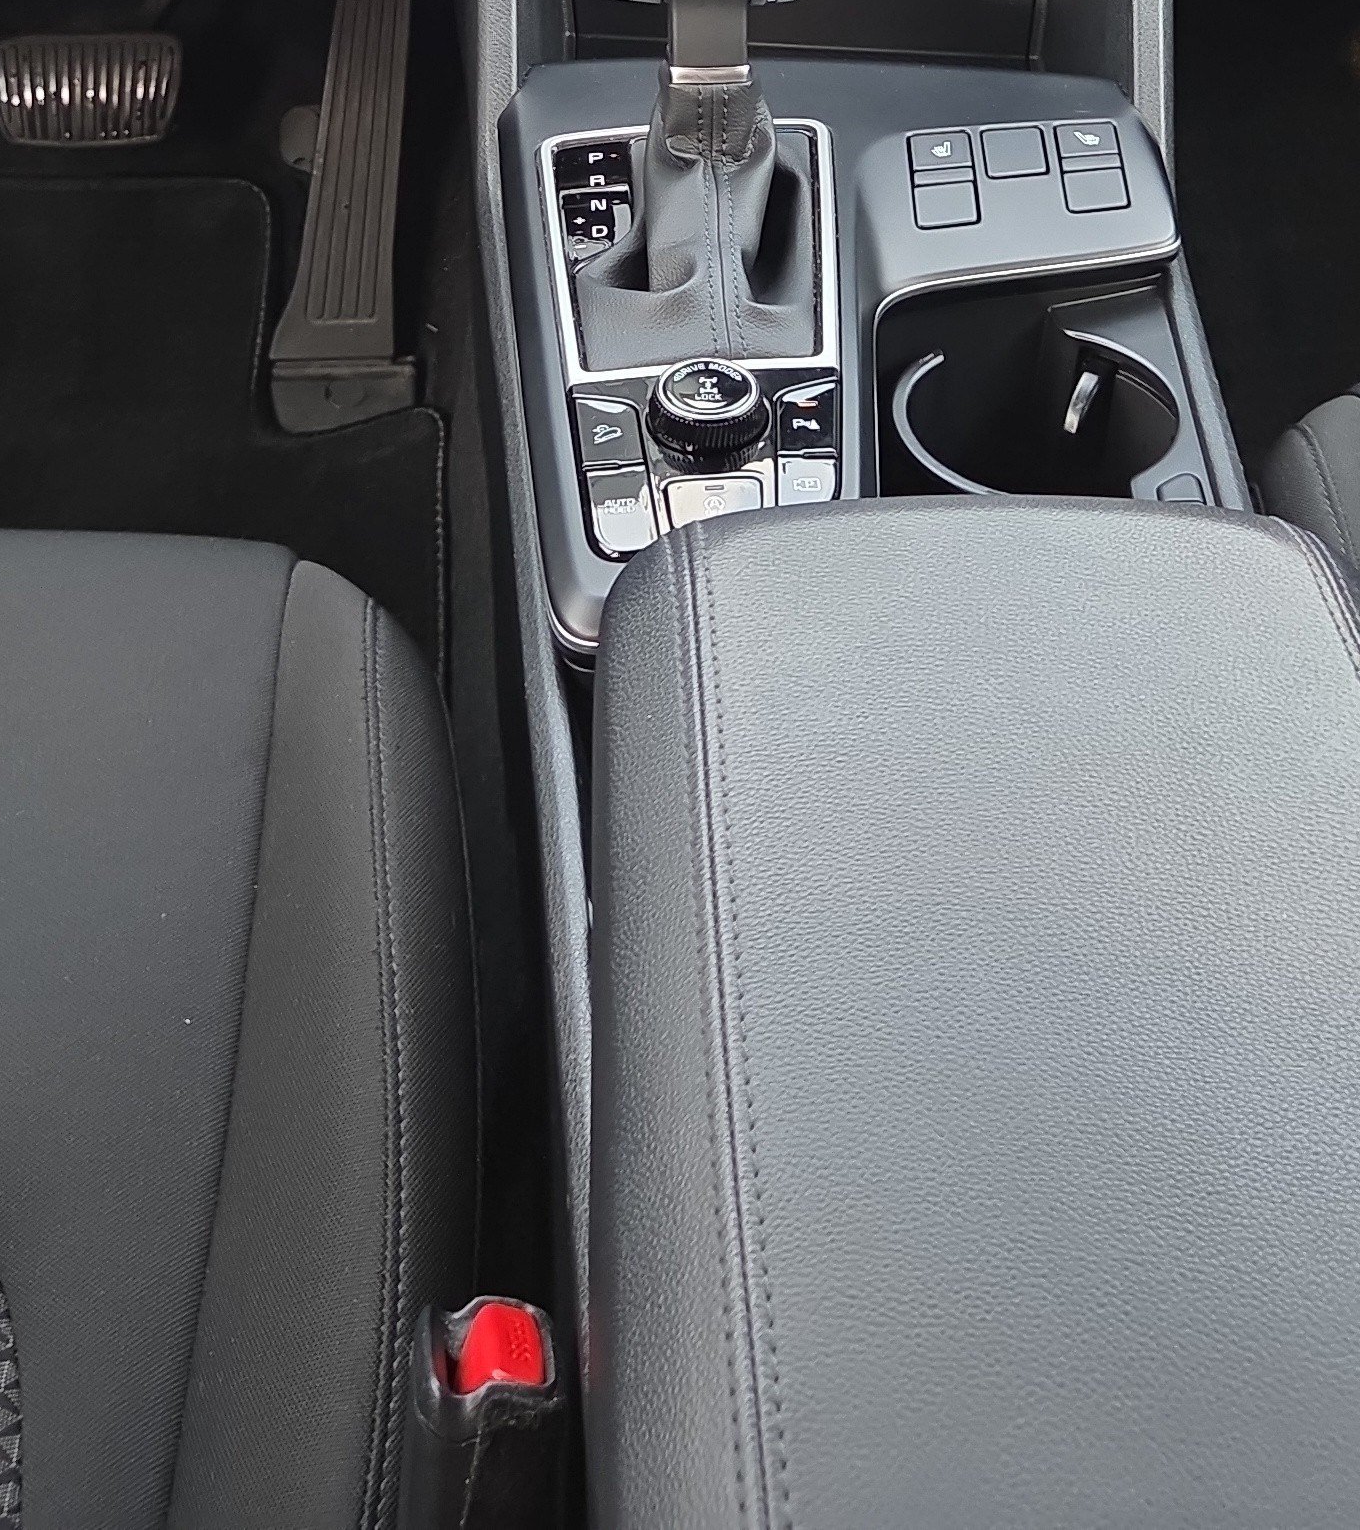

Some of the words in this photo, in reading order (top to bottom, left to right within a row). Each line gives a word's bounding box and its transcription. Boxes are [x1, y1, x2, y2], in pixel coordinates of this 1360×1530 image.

[588, 152, 604, 164] P
[589, 174, 606, 187] R
[590, 198, 607, 212] N
[591, 225, 608, 238] D
[695, 393, 722, 401] LOCK
[604, 498, 636, 506] AUTO
